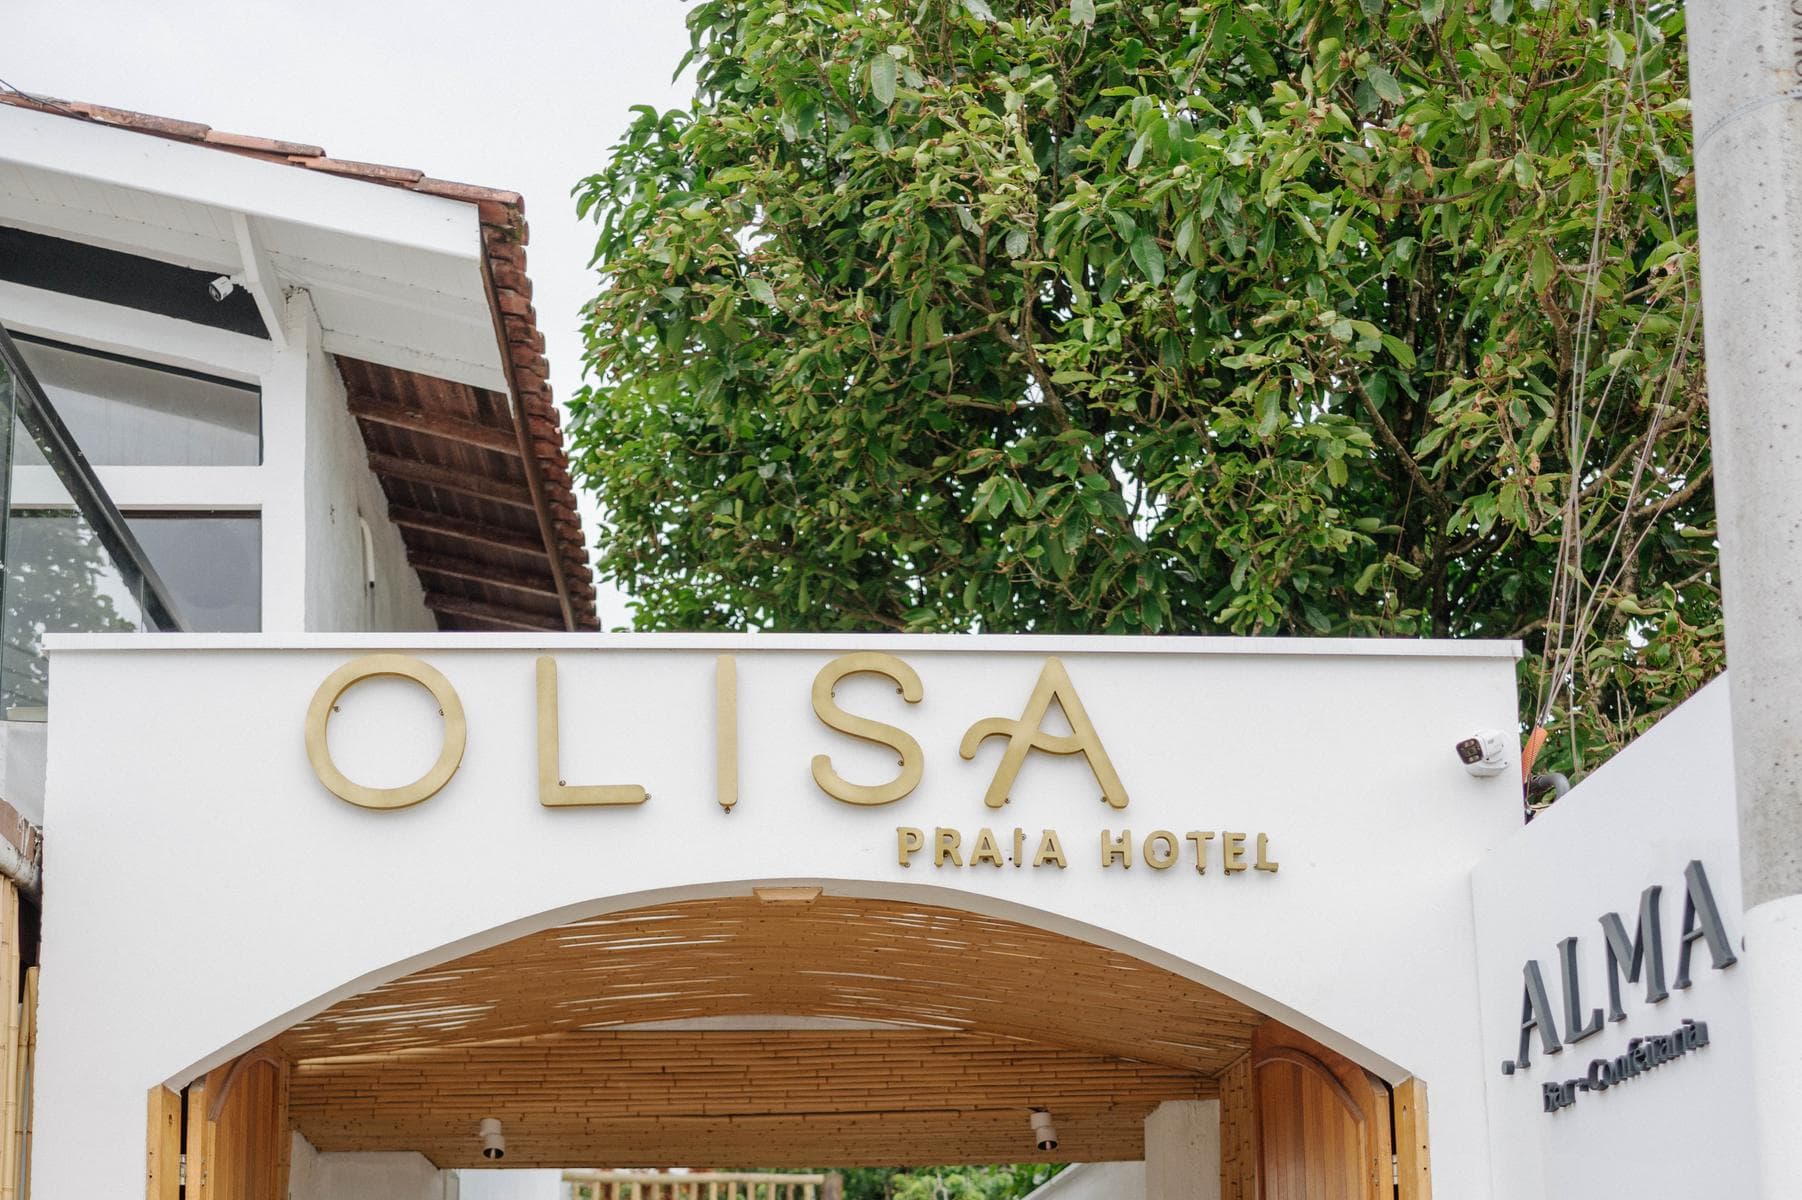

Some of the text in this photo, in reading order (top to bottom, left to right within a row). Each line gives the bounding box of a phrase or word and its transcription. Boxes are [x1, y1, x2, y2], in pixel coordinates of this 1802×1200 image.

[304, 651, 1130, 811] OLISA
[896, 826, 1279, 873] PRAIA HOTEL
